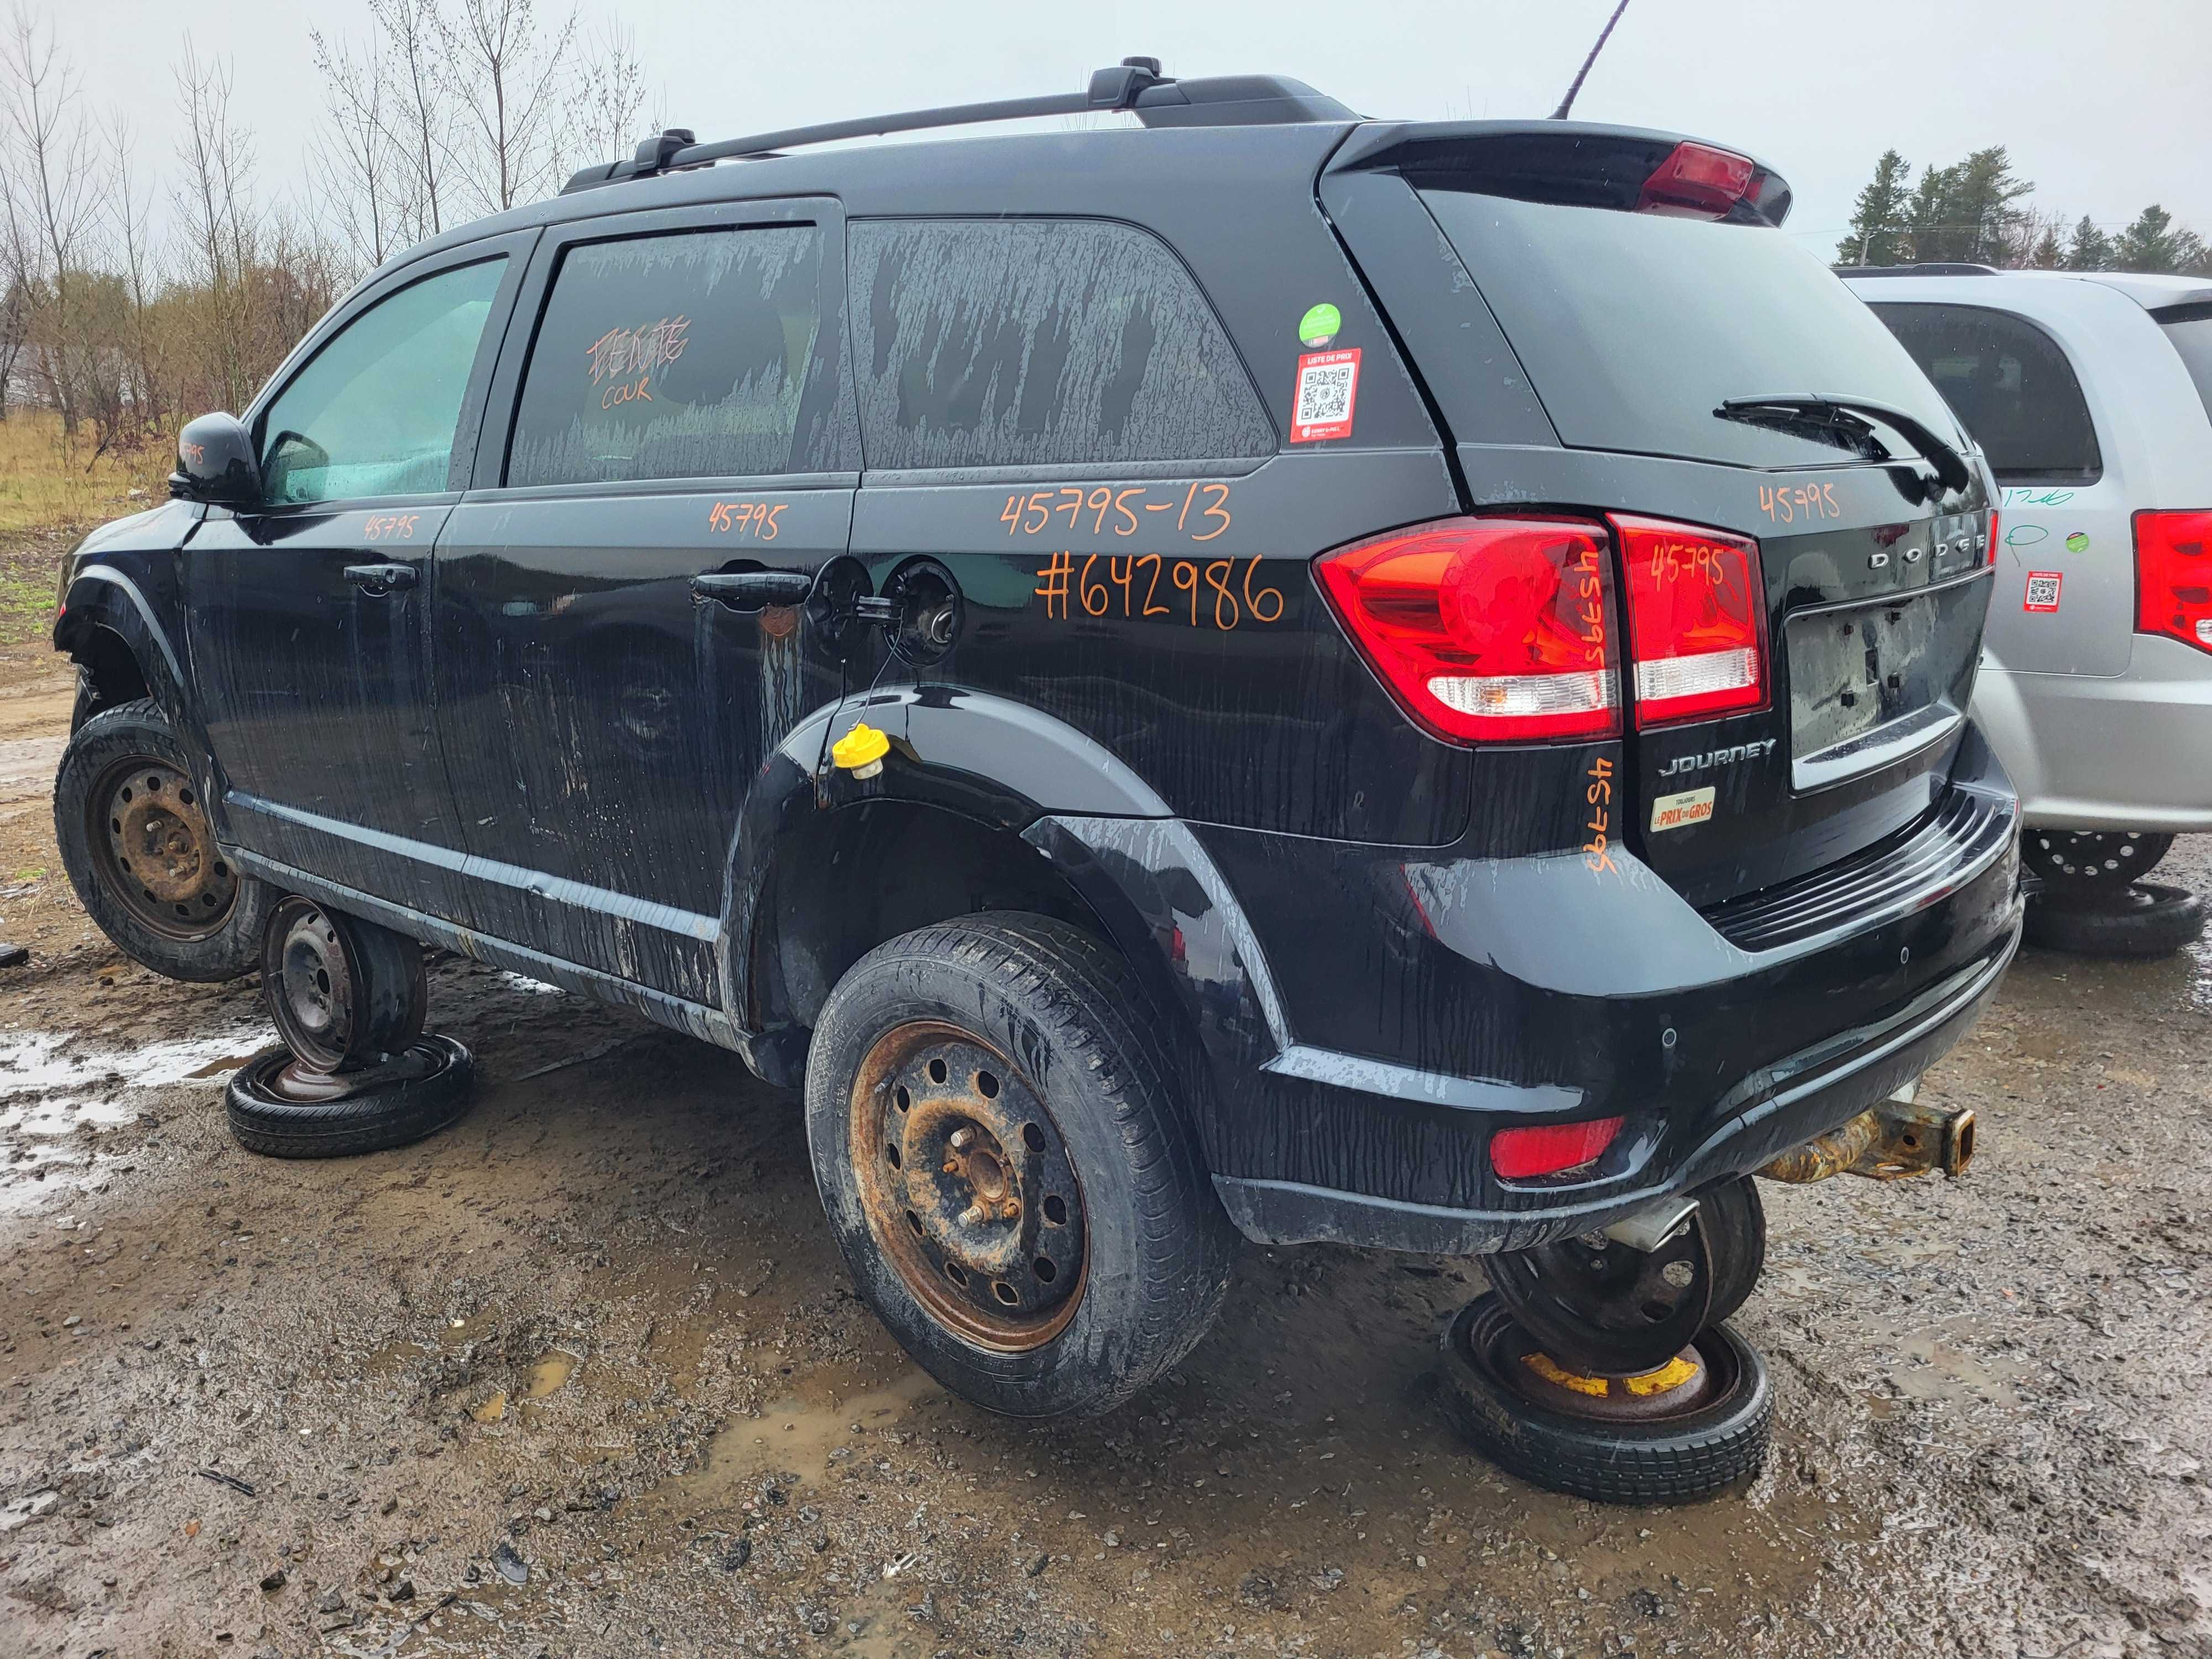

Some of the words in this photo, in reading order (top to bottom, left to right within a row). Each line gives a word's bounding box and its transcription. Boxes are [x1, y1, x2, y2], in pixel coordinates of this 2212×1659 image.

[1307, 356, 1326, 364] LISTE
[1336, 352, 1353, 361] PRIX
[602, 376, 653, 410] COUR
[708, 501, 789, 541] 45795
[999, 481, 1232, 541] 45795-13
[1759, 482, 1841, 523] 45795
[363, 514, 421, 541] 45795
[1650, 544, 1724, 592] 45795
[1869, 534, 1985, 570] DODGE
[1034, 550, 1284, 631] #642986
[1574, 551, 1605, 667] 45795
[1658, 738, 1777, 777] JOURNEY
[1583, 757, 1617, 875] 45795
[1654, 816, 1660, 825] LE
[1660, 807, 1683, 826] PRIX
[1689, 801, 1713, 819] GROS
[1676, 795, 1695, 806] TOUJOURS
